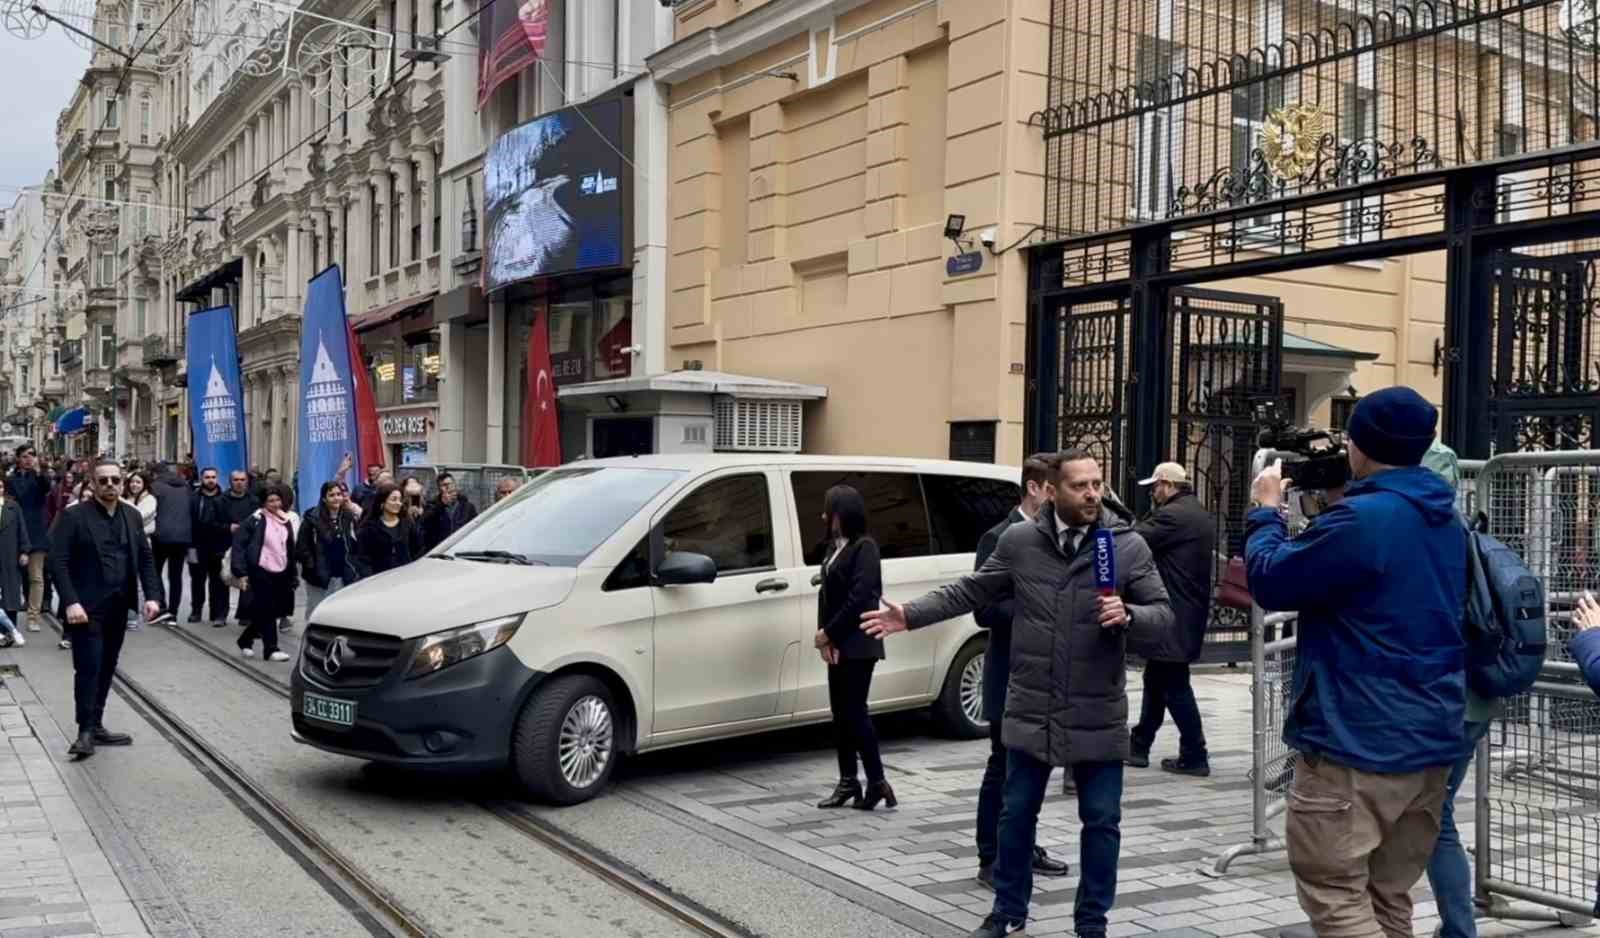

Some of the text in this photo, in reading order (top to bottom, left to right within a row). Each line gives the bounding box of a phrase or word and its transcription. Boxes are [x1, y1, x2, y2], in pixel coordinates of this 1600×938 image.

[407, 416, 425, 432] ROSE
[1097, 537, 1110, 582] РОССИЯ
[318, 700, 328, 717] CC
[329, 702, 351, 722] 3311
